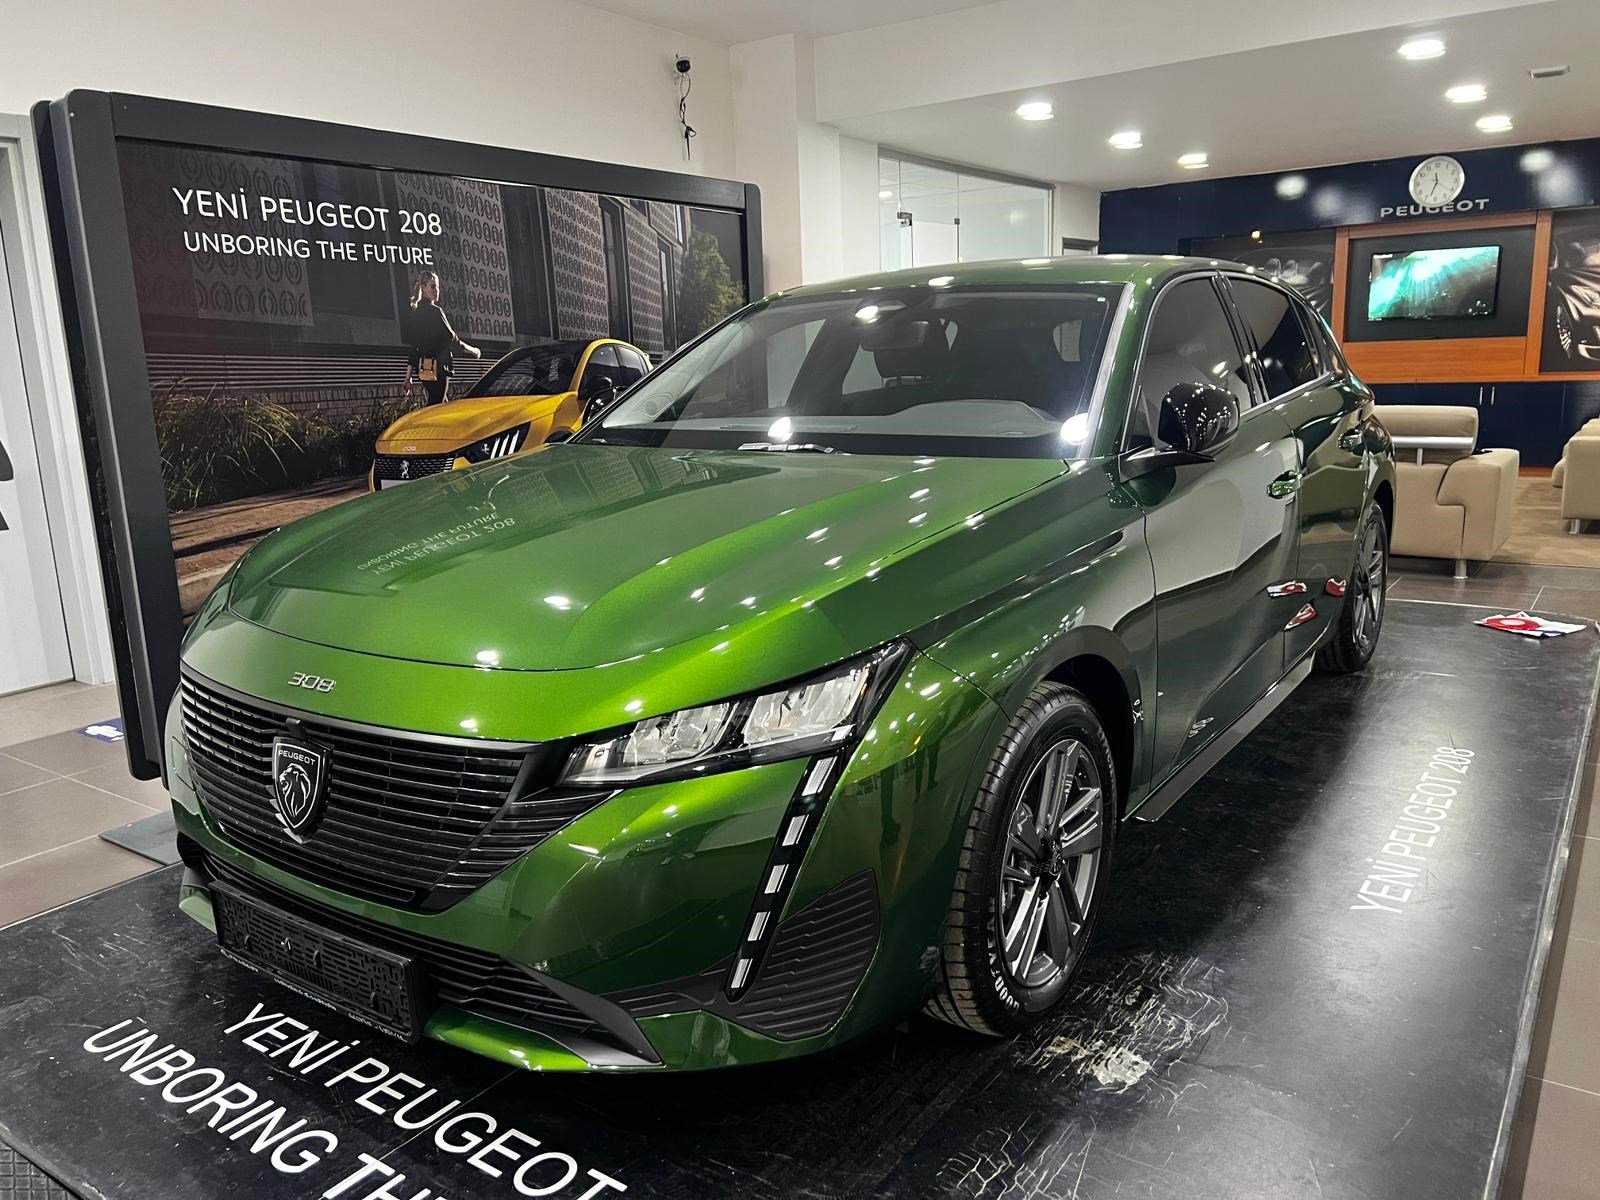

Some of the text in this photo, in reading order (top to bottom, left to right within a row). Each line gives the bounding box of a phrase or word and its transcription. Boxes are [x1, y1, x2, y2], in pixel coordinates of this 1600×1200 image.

[172, 187, 443, 236] YENİ PEUGEOT 208
[183, 231, 434, 265] UNBORING THE FUTURE
[287, 671, 337, 693] 308
[278, 749, 316, 766] PEUGEOT
[1350, 746, 1475, 914] YENİ PEUGEOT 208
[82, 1019, 339, 1174] UNBORING
[223, 1002, 628, 1200] YENİ PEUGEOT
